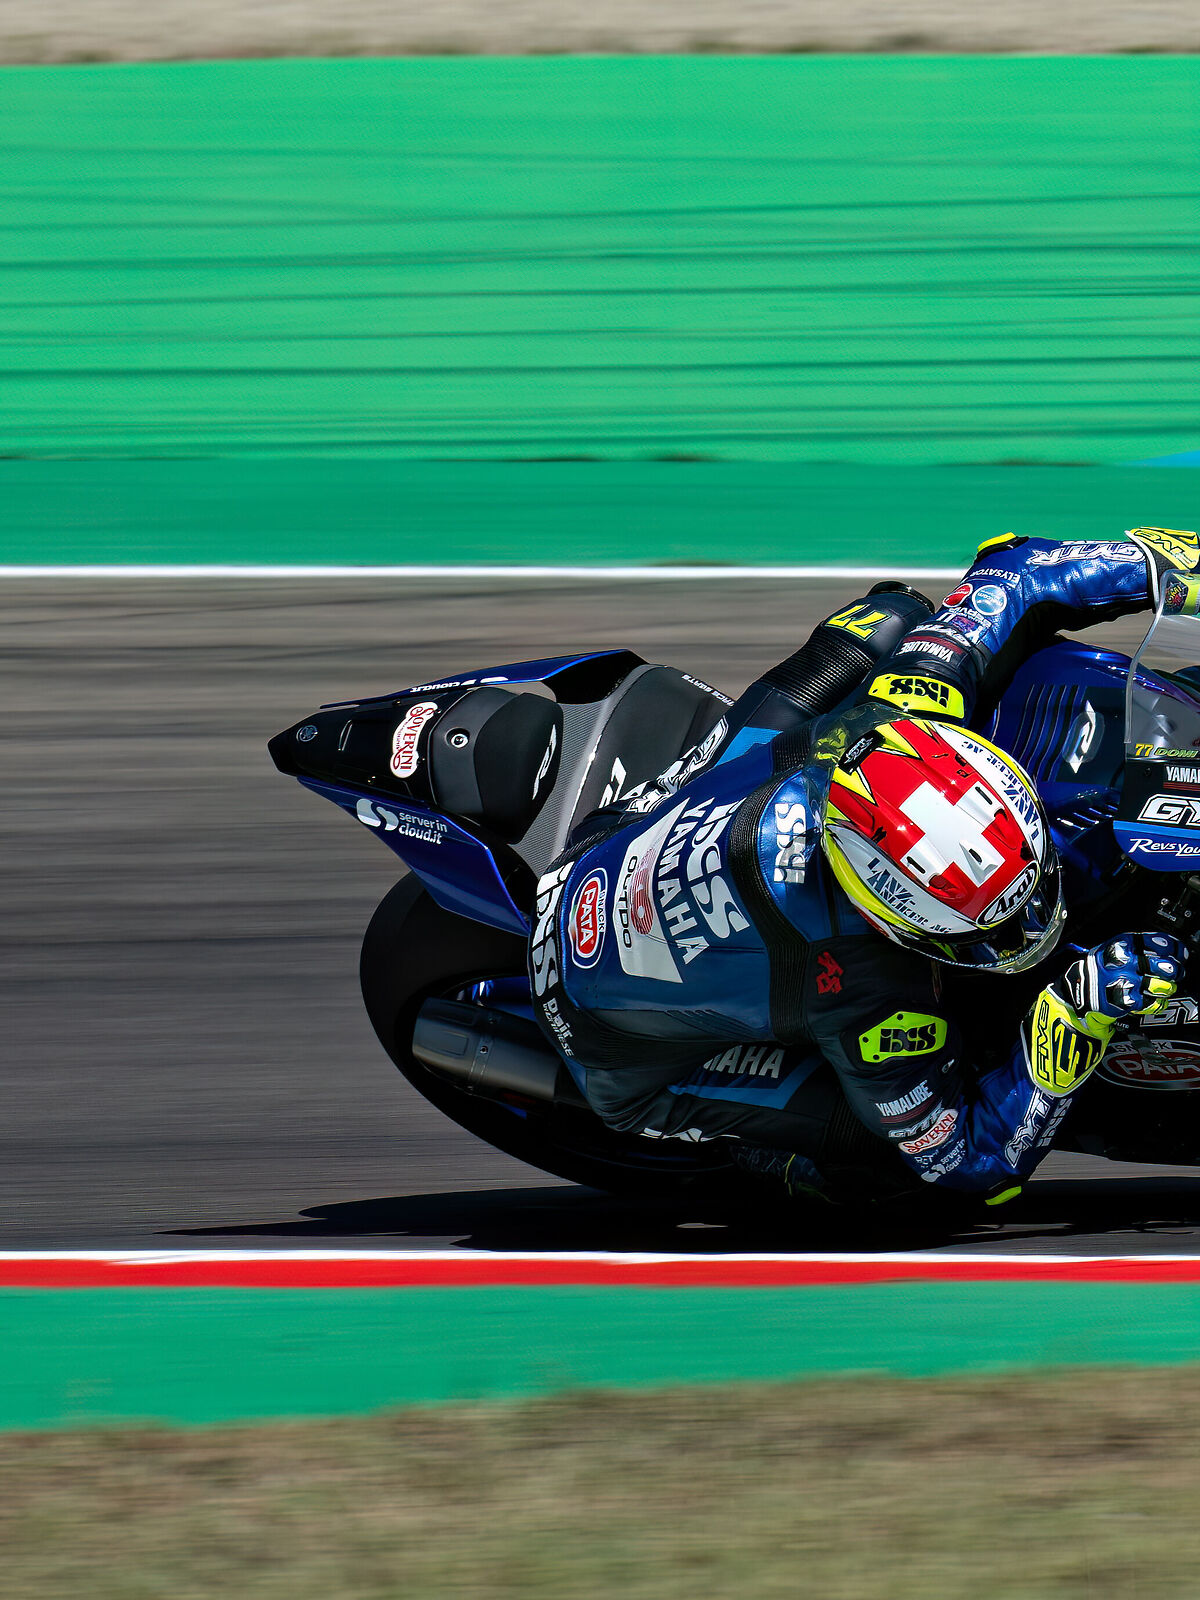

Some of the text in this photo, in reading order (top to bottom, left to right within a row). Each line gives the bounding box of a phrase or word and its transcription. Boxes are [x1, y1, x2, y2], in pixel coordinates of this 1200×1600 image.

[823, 604, 892, 641] 77
[393, 706, 437, 770] SOVERINI
[1134, 743, 1154, 757] 77
[399, 812, 434, 828] server
[399, 822, 443, 845] cloud.it
[657, 797, 710, 965] YAMAHA
[984, 869, 1035, 923] Arai
[579, 886, 598, 946] PATA
[1036, 1000, 1051, 1082] FIVE
[875, 1080, 933, 1117] YAMALUBE
[903, 1112, 955, 1153] SOVERINI
